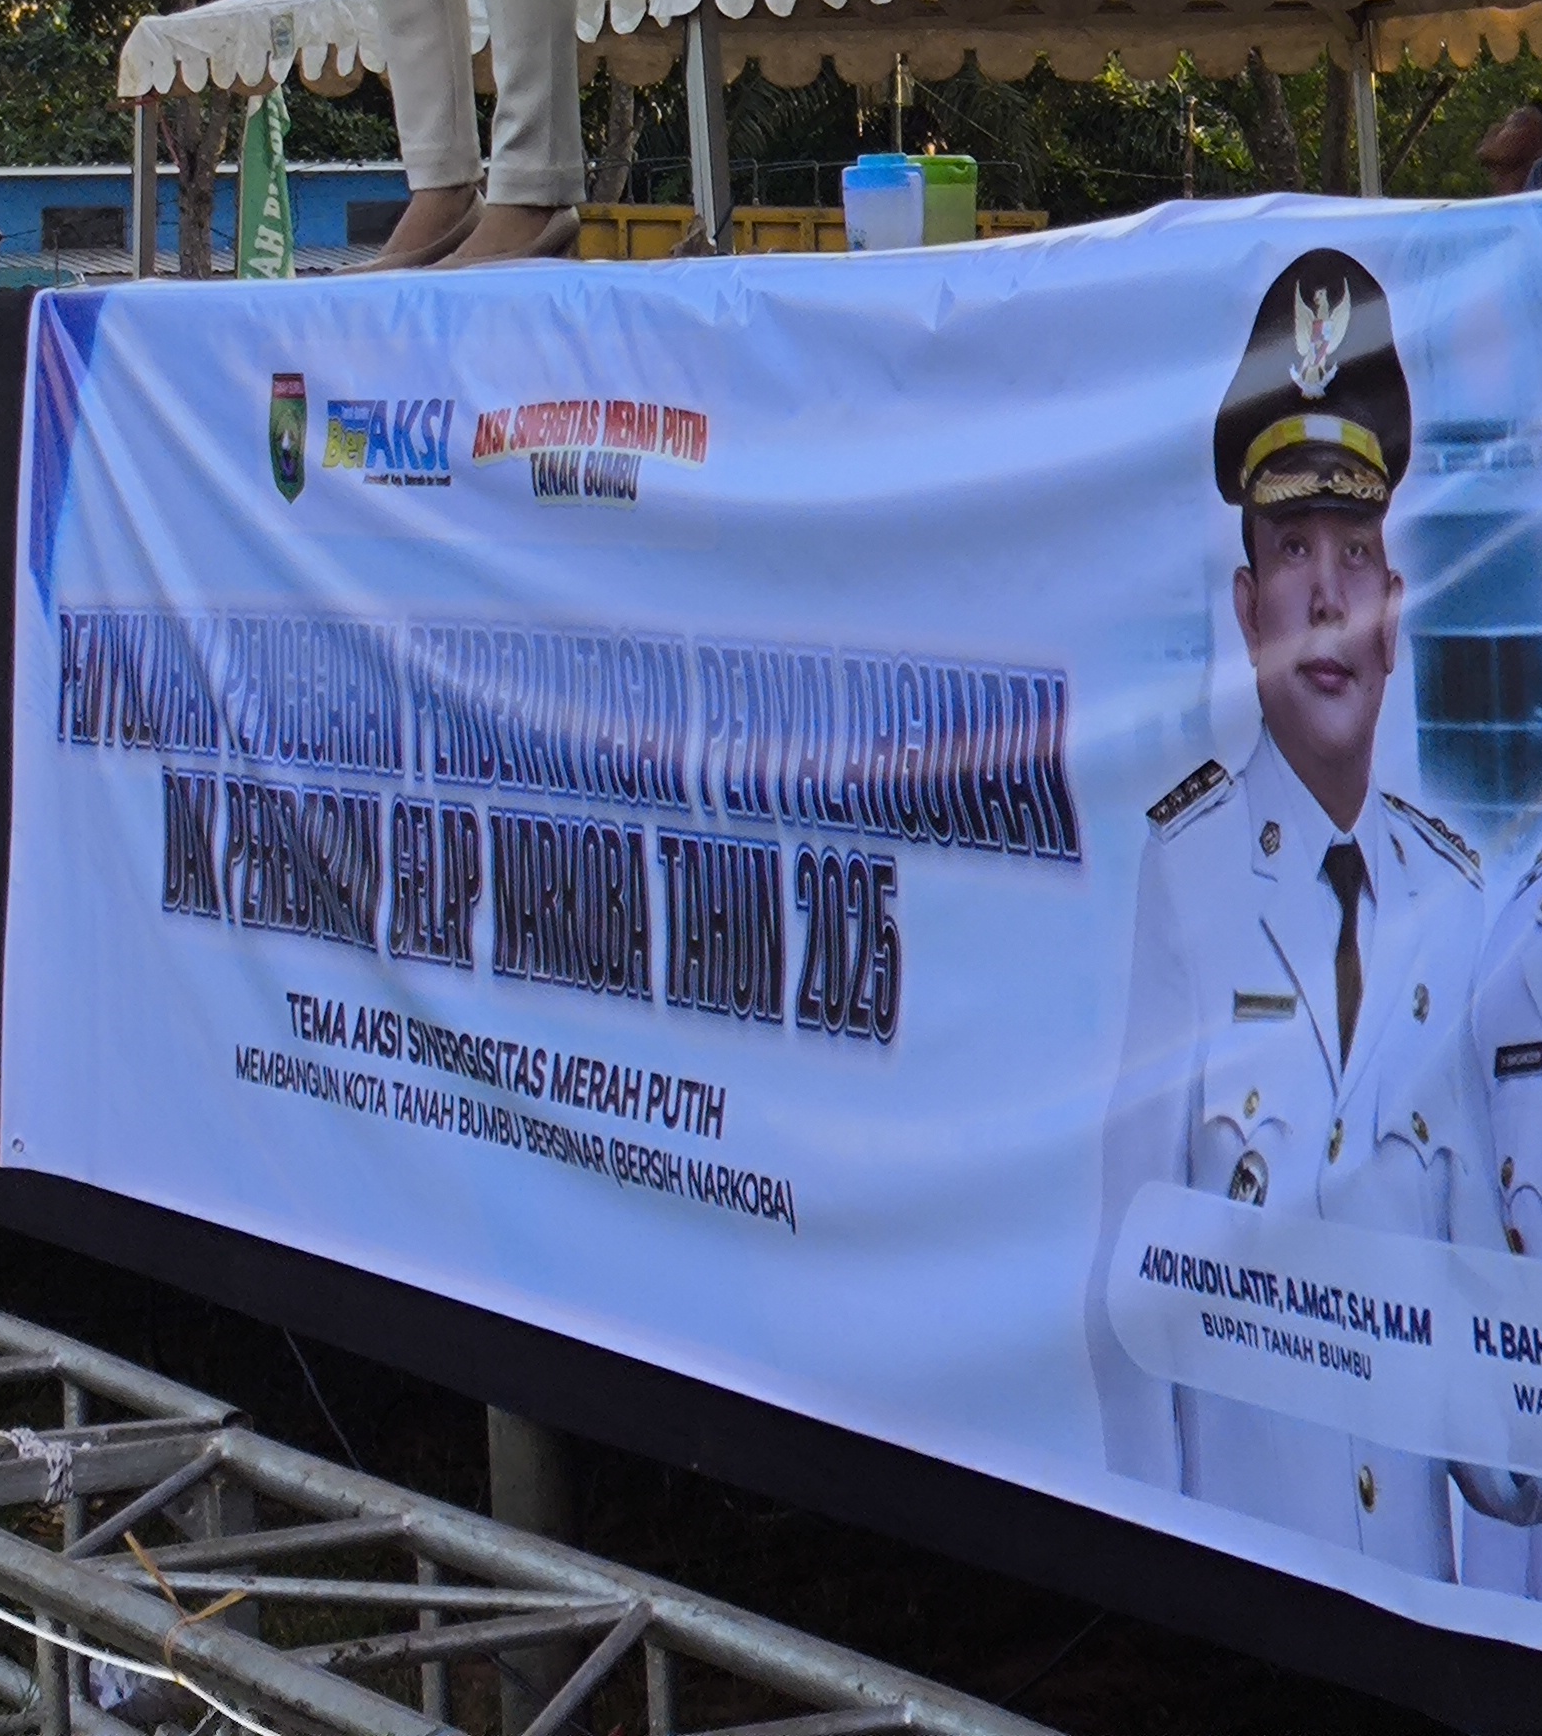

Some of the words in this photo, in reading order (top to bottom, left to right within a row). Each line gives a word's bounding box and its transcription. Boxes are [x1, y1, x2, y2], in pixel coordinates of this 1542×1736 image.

[473, 408, 512, 459] AKSI
[603, 400, 658, 452] MERAH
[662, 406, 708, 463] PUTIH
[530, 451, 581, 497] TANAH
[584, 452, 641, 501] BUMBU
[222, 612, 404, 775] PENCEGAHAN
[407, 619, 690, 809] PEMBERANTASAN
[695, 638, 1081, 862] PENYALAHGUNAAN
[163, 766, 220, 919] DAN
[224, 774, 383, 953] PEREDARAN
[389, 795, 483, 966] GELAP
[489, 806, 653, 1001] NARKOBA
[657, 826, 786, 1023] TAHUN
[795, 841, 901, 1044] 2025
[286, 992, 348, 1049] TEMA
[351, 1006, 403, 1061] AKSI
[406, 1016, 547, 1100] SINERGISITAS
[550, 1052, 643, 1121] MERAH
[645, 1072, 727, 1140] PUTIH
[236, 1044, 341, 1105] MEMBANGUN
[343, 1070, 387, 1118] KOTA
[392, 1081, 455, 1133] TANAH
[458, 1097, 522, 1151] BUMBU
[520, 1115, 610, 1176] BERSINAR
[609, 1136, 685, 1197] (BERSIH
[687, 1158, 797, 1235] NARKOBA)
[1139, 1245, 1180, 1287] ANDI
[1180, 1254, 1226, 1298] RUDI
[1225, 1265, 1284, 1314] LATIF,
[1383, 1300, 1434, 1346] M.M
[1472, 1316, 1498, 1357] H.
[1200, 1311, 1260, 1349] BUPATI
[1262, 1326, 1315, 1365] TANAH
[1318, 1340, 1373, 1382] BUMBU
